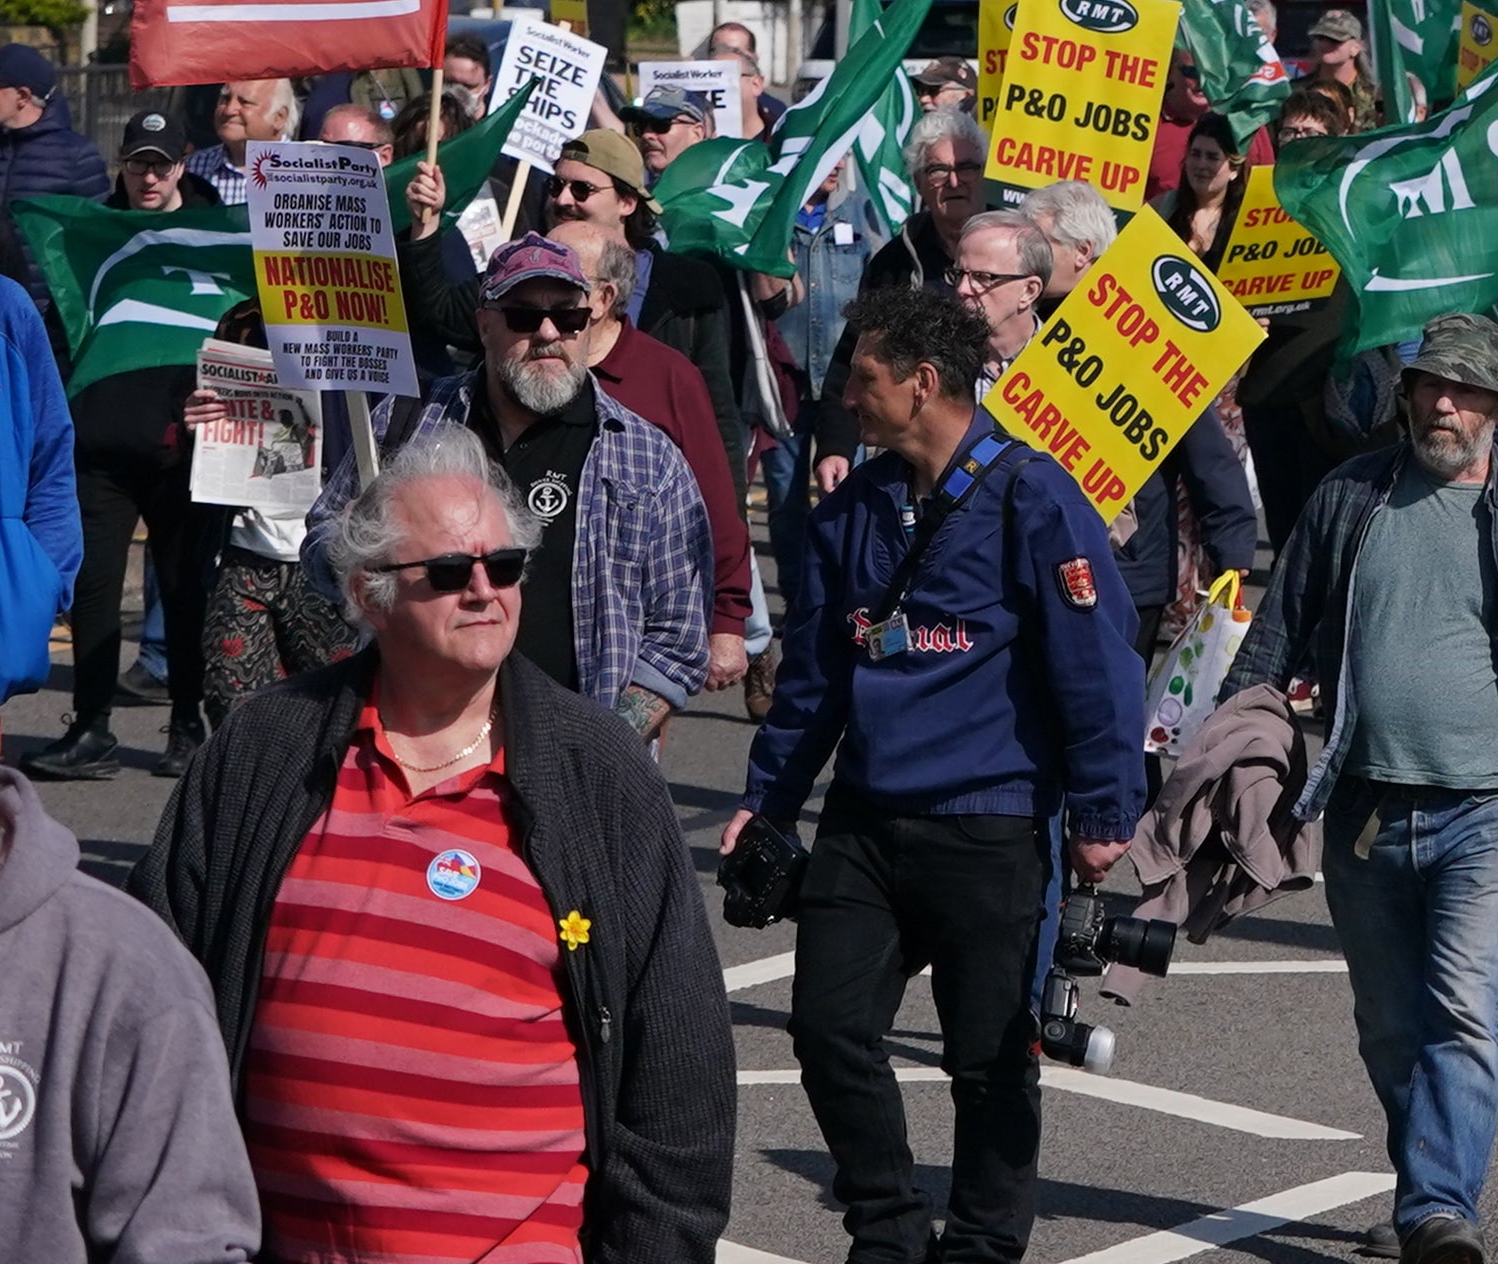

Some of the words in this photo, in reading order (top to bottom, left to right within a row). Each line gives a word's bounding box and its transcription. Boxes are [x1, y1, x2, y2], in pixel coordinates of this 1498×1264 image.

[1076, 0, 1126, 24] RMT
[517, 45, 588, 88] SEIZE
[1020, 31, 1096, 73] STOP
[1103, 49, 1159, 88] THE
[1005, 83, 1067, 122] P&O
[1074, 101, 1152, 142] JOBS
[996, 137, 1093, 185] CARVE
[1100, 161, 1141, 195] UP
[274, 193, 332, 212] ORGANISE
[335, 195, 366, 214] MASS
[264, 212, 325, 230] WORKERS'
[329, 215, 367, 233] ACTION
[370, 217, 381, 234] TO
[283, 232, 314, 248] SAVE
[318, 232, 341, 249] OUR
[344, 234, 372, 251] JOBS
[1227, 241, 1278, 264] P&O
[264, 255, 395, 294] NATIONALISE
[1300, 269, 1334, 290] UP
[283, 290, 328, 320] P&O
[336, 291, 389, 326] NOW!
[1164, 271, 1211, 325] RMT
[326, 330, 350, 344] BUILD
[352, 330, 359, 343] A
[1087, 273, 1159, 348] STOP
[1152, 340, 1210, 409] THE
[283, 342, 301, 355] NEW
[304, 343, 330, 355] MASS
[376, 346, 399, 360] PARTY
[300, 355, 311, 368] TO
[313, 355, 339, 369] FIGHT
[341, 356, 356, 370] THE
[358, 357, 388, 372] BOSSES
[202, 363, 258, 383] SOCIALIST
[304, 368, 323, 381] AND
[325, 368, 345, 381] GIVE
[347, 369, 358, 382] US
[368, 371, 390, 384] VOICE
[1042, 318, 1104, 388] P&O
[1096, 384, 1169, 461] JOBS
[261, 399, 276, 421] &
[203, 419, 264, 447] FIGHT!
[1002, 372, 1092, 472] CARVE
[1082, 459, 1126, 504] UP
[0, 1055, 42, 1085] SHIPPING
